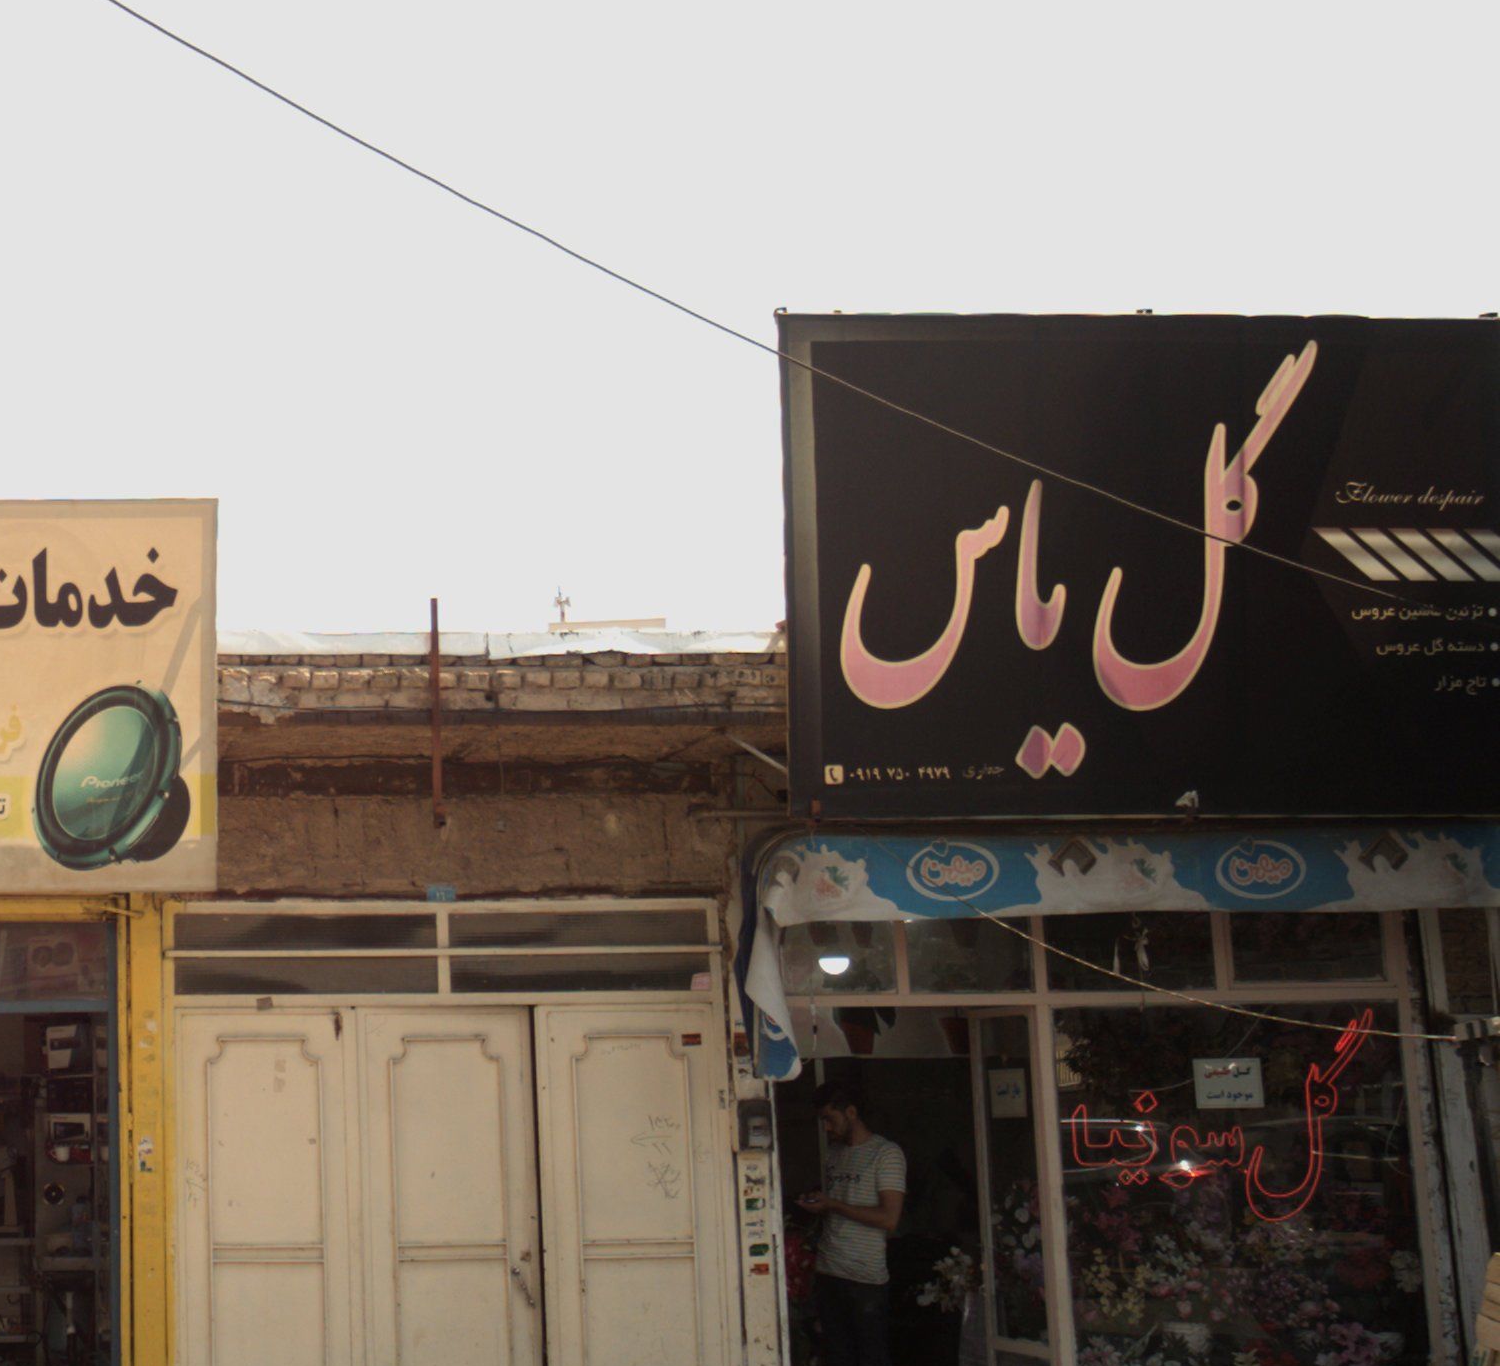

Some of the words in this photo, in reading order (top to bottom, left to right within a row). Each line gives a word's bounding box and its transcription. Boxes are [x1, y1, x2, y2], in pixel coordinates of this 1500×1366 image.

[1335, 481, 1413, 504] Flower
[1417, 485, 1485, 512] despair
[1092, 338, 1319, 712] گل
[1351, 606, 1396, 621] عروس
[839, 479, 1088, 780] یاس
[1376, 642, 1421, 657] عروس
[1424, 638, 1445, 656] گل
[1447, 641, 1485, 654] دسته
[1466, 676, 1487, 695] تاج
[920, 853, 988, 888] میهن
[1228, 852, 1295, 886] میهن
[1246, 1008, 1374, 1222] گل
